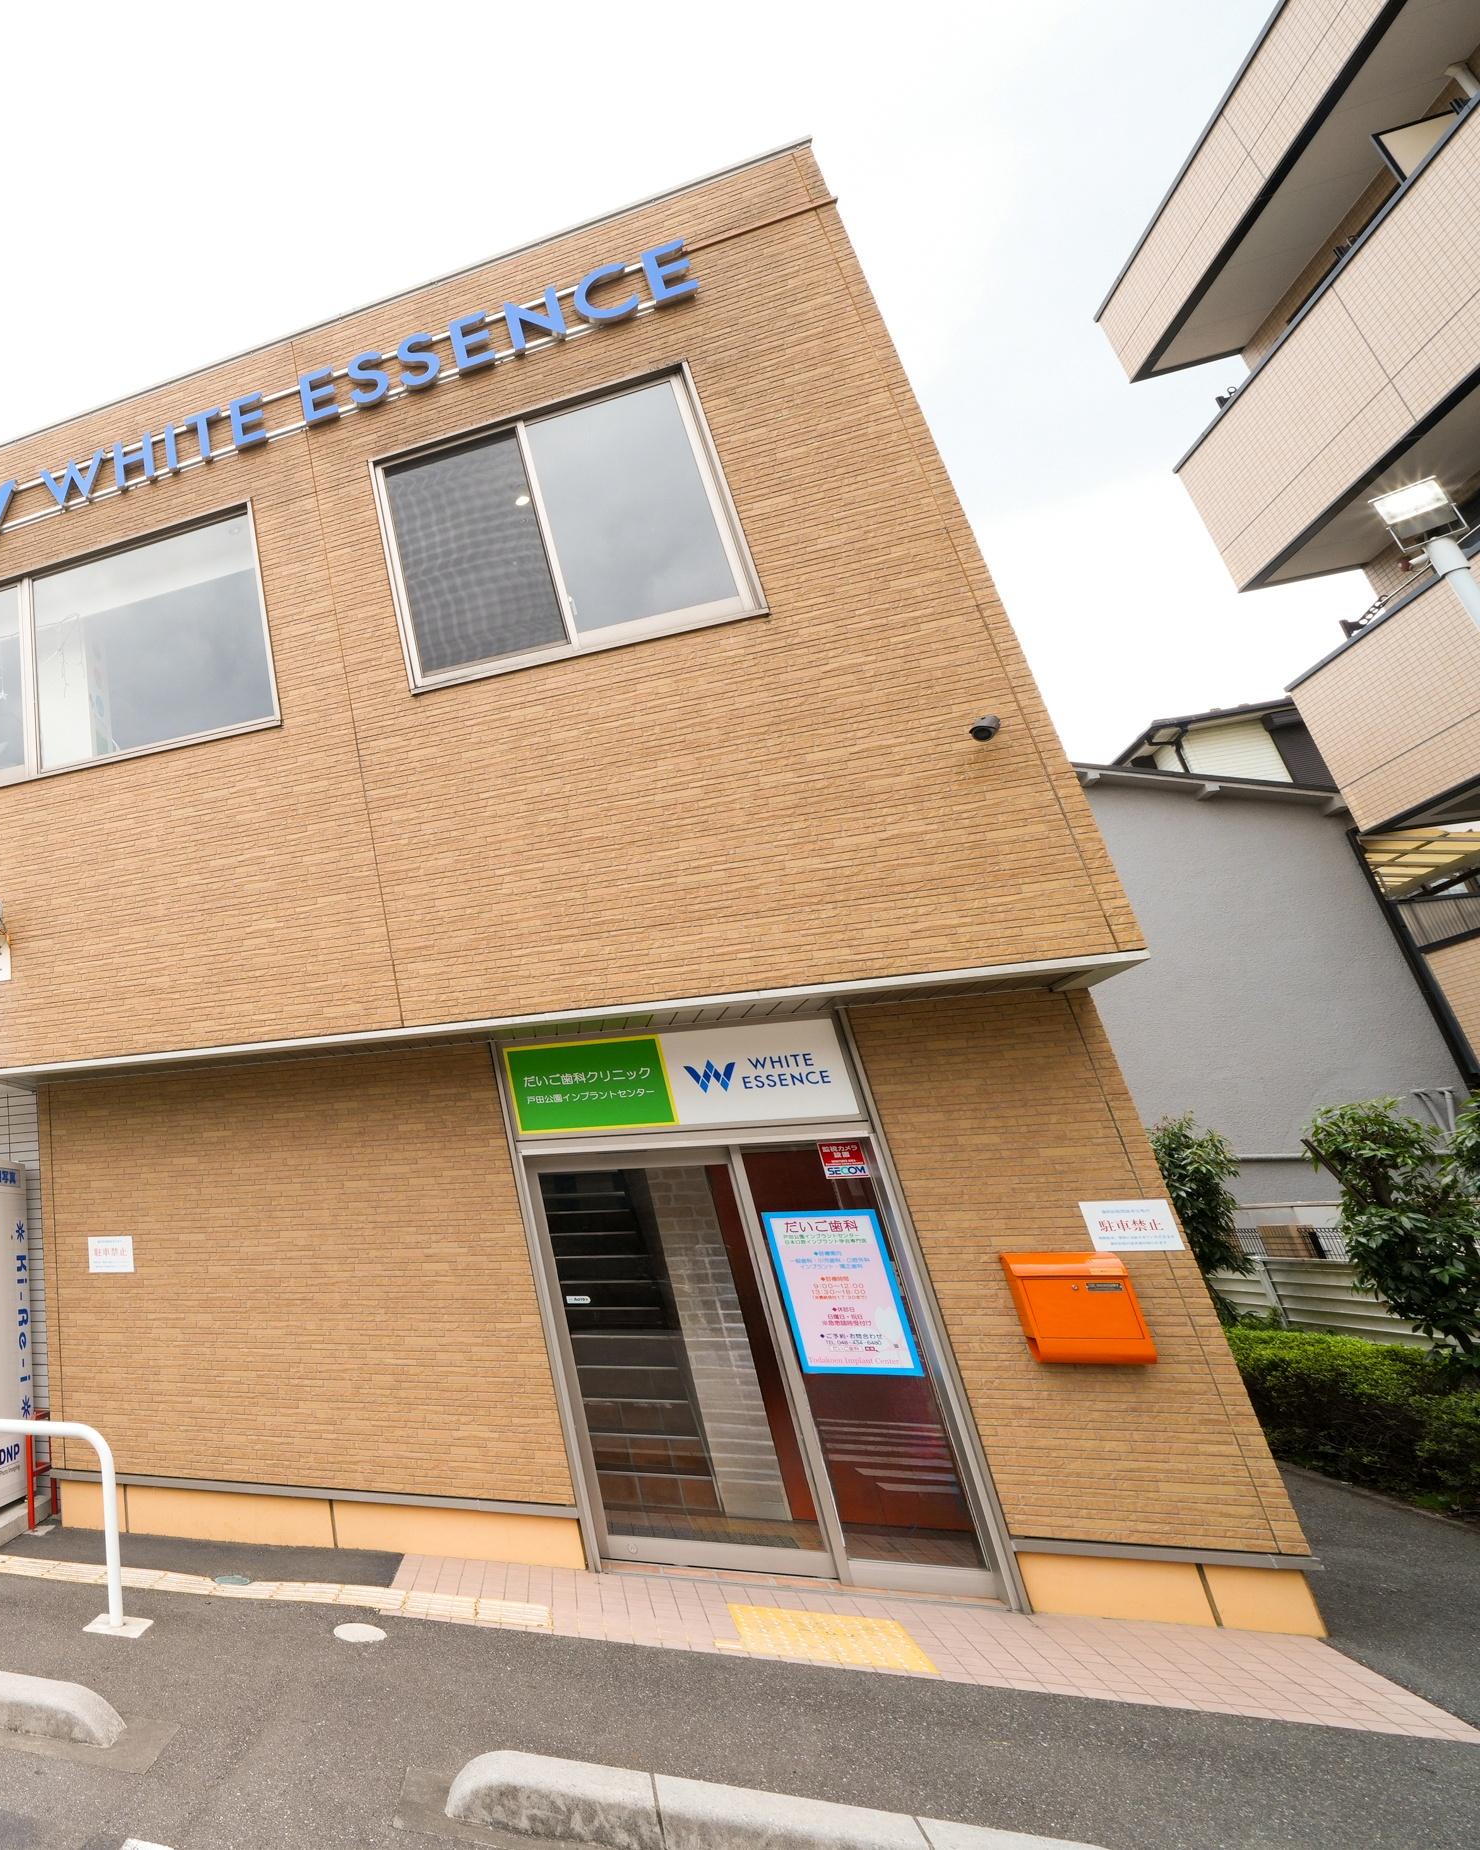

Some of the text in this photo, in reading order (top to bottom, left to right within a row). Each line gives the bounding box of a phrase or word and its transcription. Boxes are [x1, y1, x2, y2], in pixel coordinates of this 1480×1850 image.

[40, 391, 266, 509] WHITE
[299, 238, 700, 426] ESSENCE
[747, 1052, 814, 1071] WHITE
[523, 1066, 652, 1088] だいご歯科クリニック
[741, 1070, 832, 1090] ESSENCE
[526, 1087, 655, 1105] 戸田公園インプラントセンター
[827, 1165, 866, 1176] SECOM
[784, 1219, 858, 1233] だいご歯科
[1098, 1218, 1164, 1232] 駐車禁止
[16, 1255, 31, 1383] Ki-Re-i
[844, 1357, 873, 1366] Implant
[875, 1357, 899, 1365] Center
[0, 1443, 20, 1466] DNP
